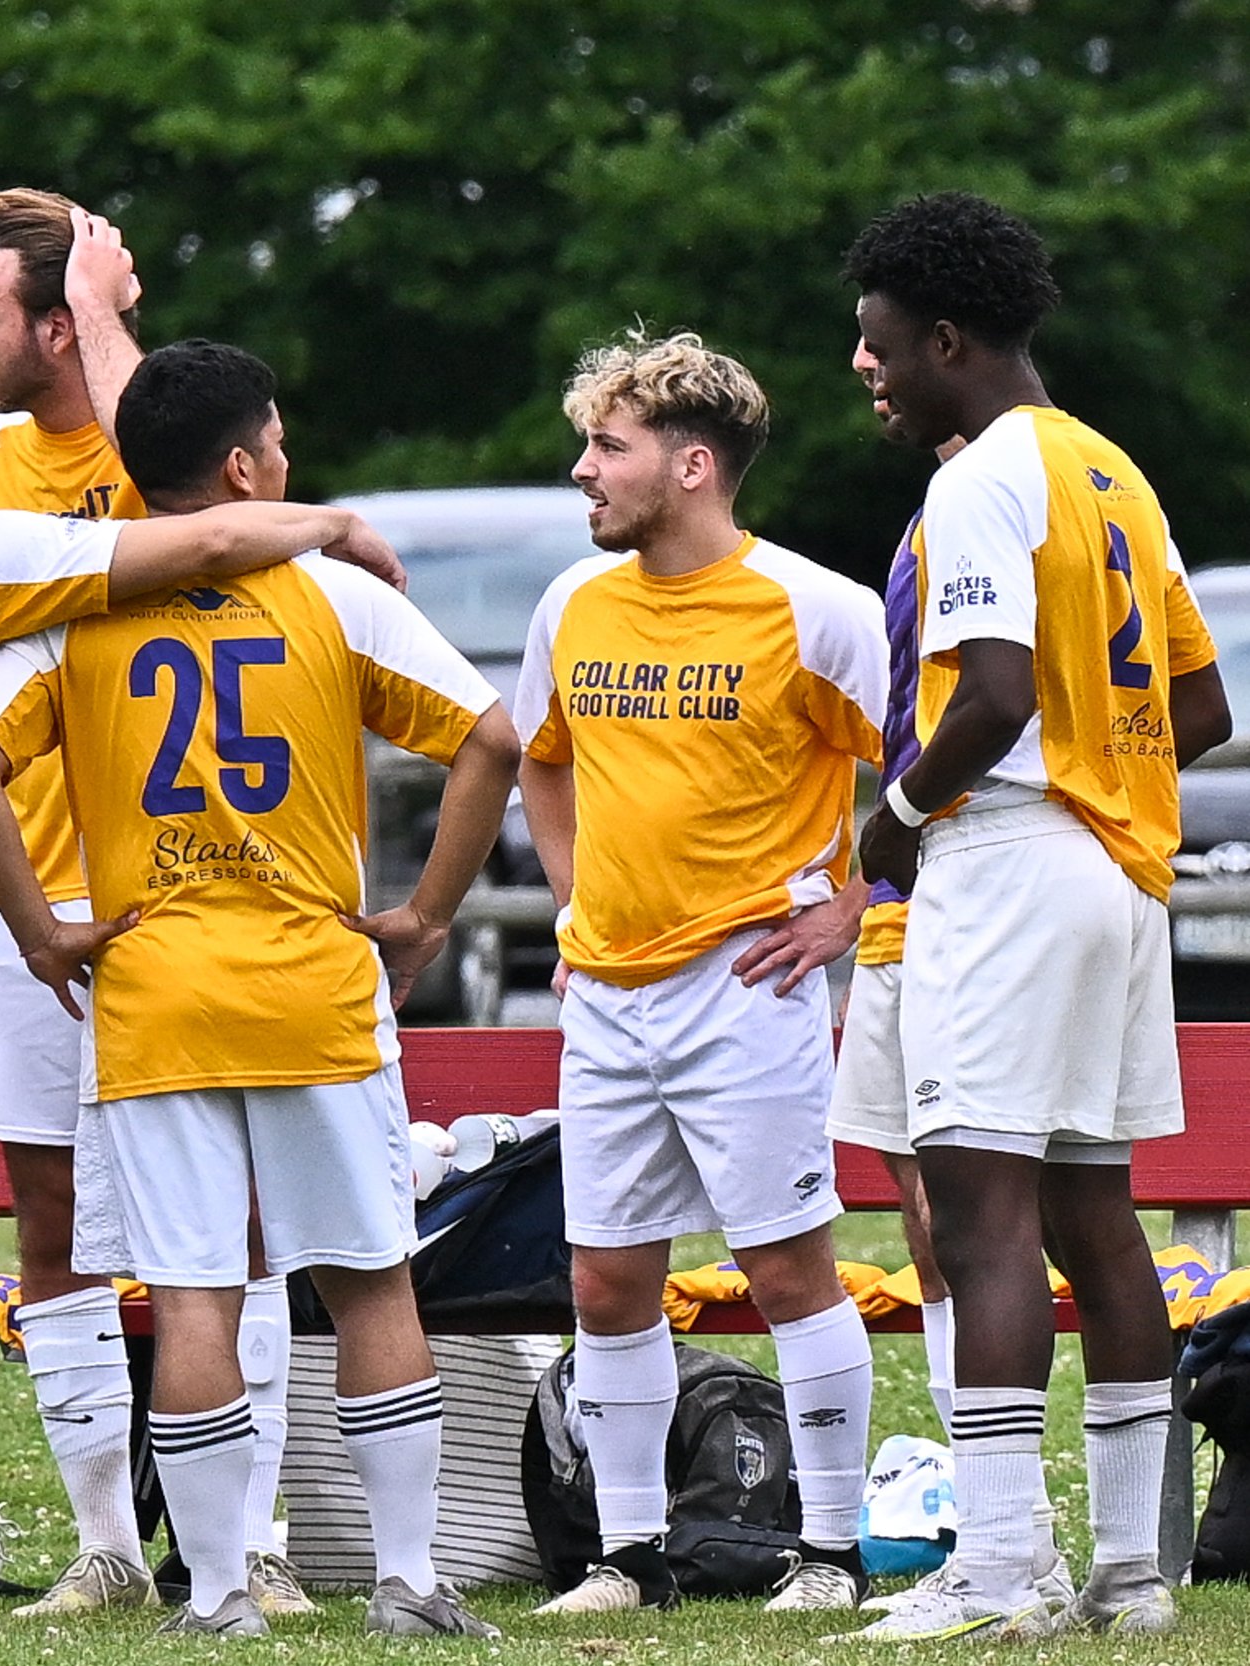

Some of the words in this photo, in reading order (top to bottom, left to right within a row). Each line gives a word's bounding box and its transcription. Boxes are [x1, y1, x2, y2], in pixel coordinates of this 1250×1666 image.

[571, 660, 669, 692] COLLAR
[677, 664, 744, 693] CITY
[569, 692, 670, 719] FOOTBALL
[678, 695, 740, 721] CLUB
[129, 637, 291, 817] 25
[1137, 743, 1174, 759] BAR
[154, 828, 280, 870] Stacks
[147, 866, 251, 889] ESPRESSO
